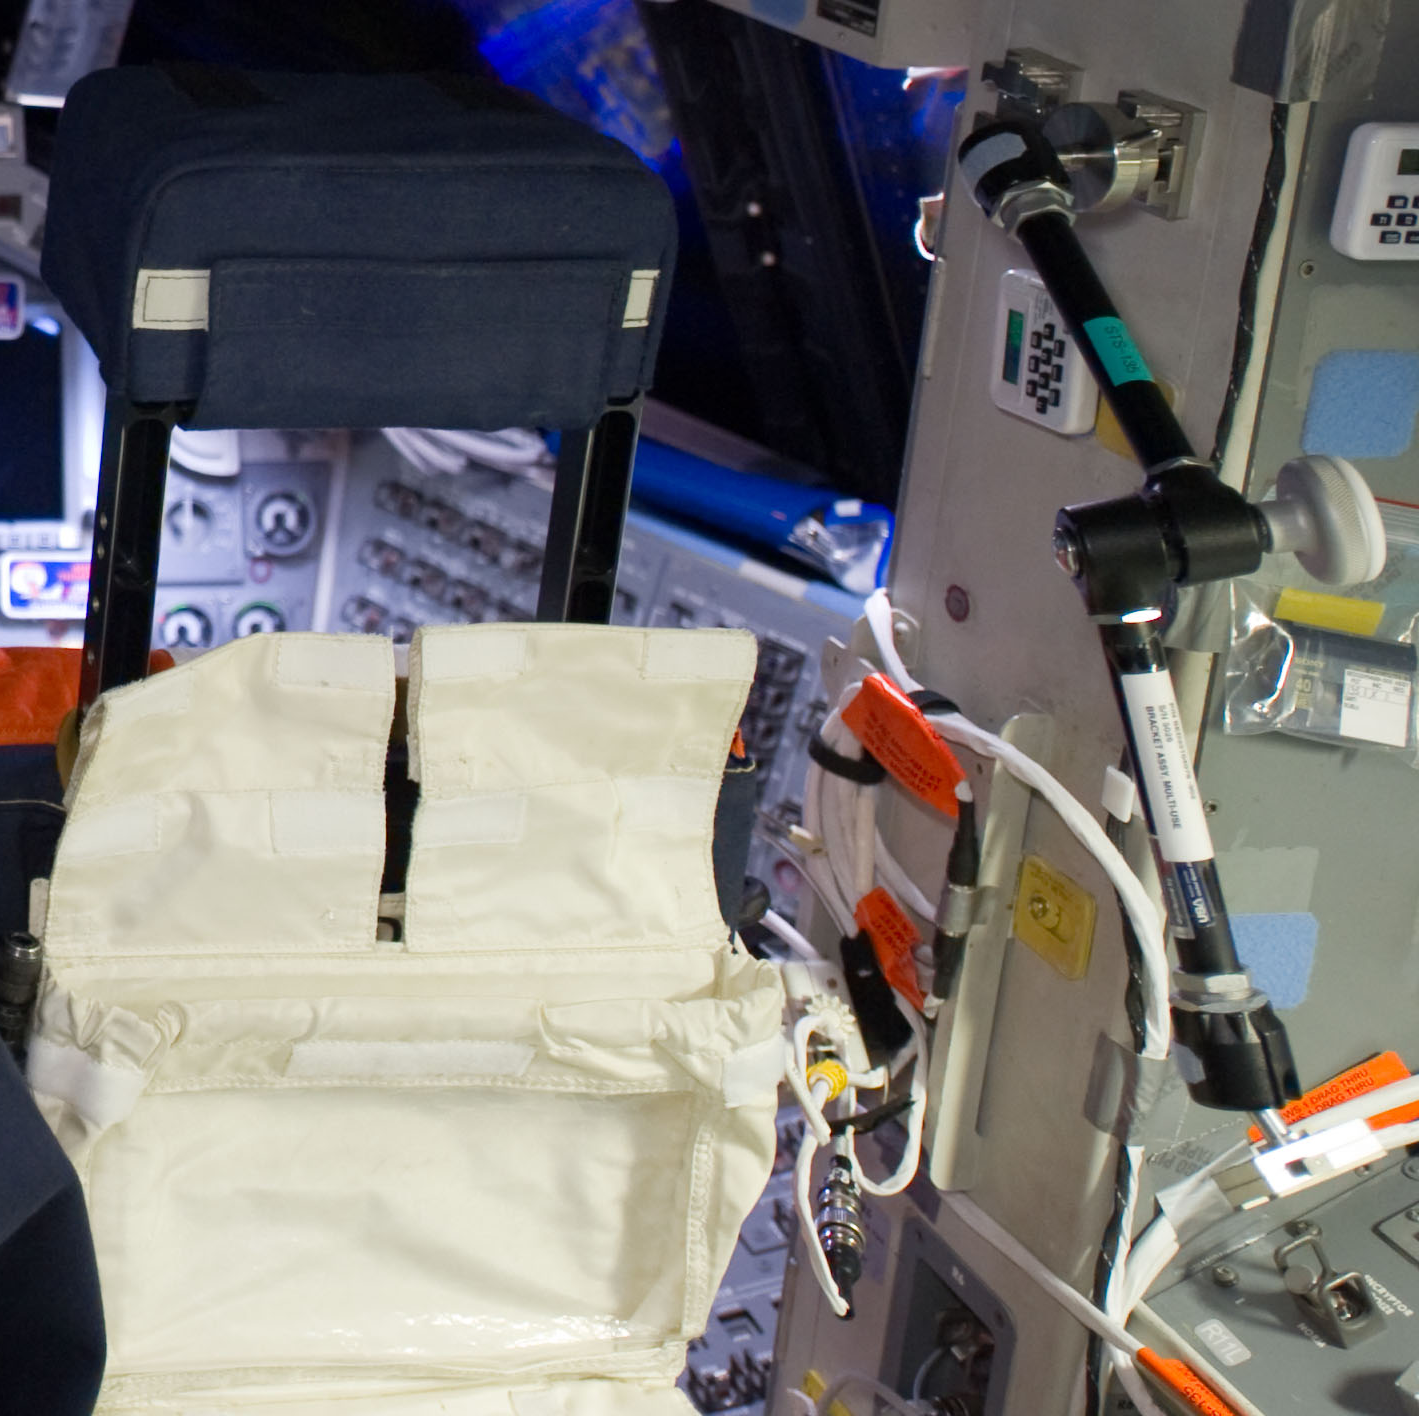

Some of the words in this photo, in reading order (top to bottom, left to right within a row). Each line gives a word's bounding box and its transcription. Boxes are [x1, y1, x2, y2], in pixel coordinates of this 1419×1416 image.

[1145, 705, 1163, 750] BRACKET
[1163, 779, 1182, 831] MULTI-USE
[1310, 1084, 1340, 1104] DRAG
[1340, 1068, 1369, 1087] THRU
[1316, 1094, 1346, 1113] DRAG
[1346, 1077, 1375, 1097] THRU
[1201, 1324, 1242, 1364] R11L
